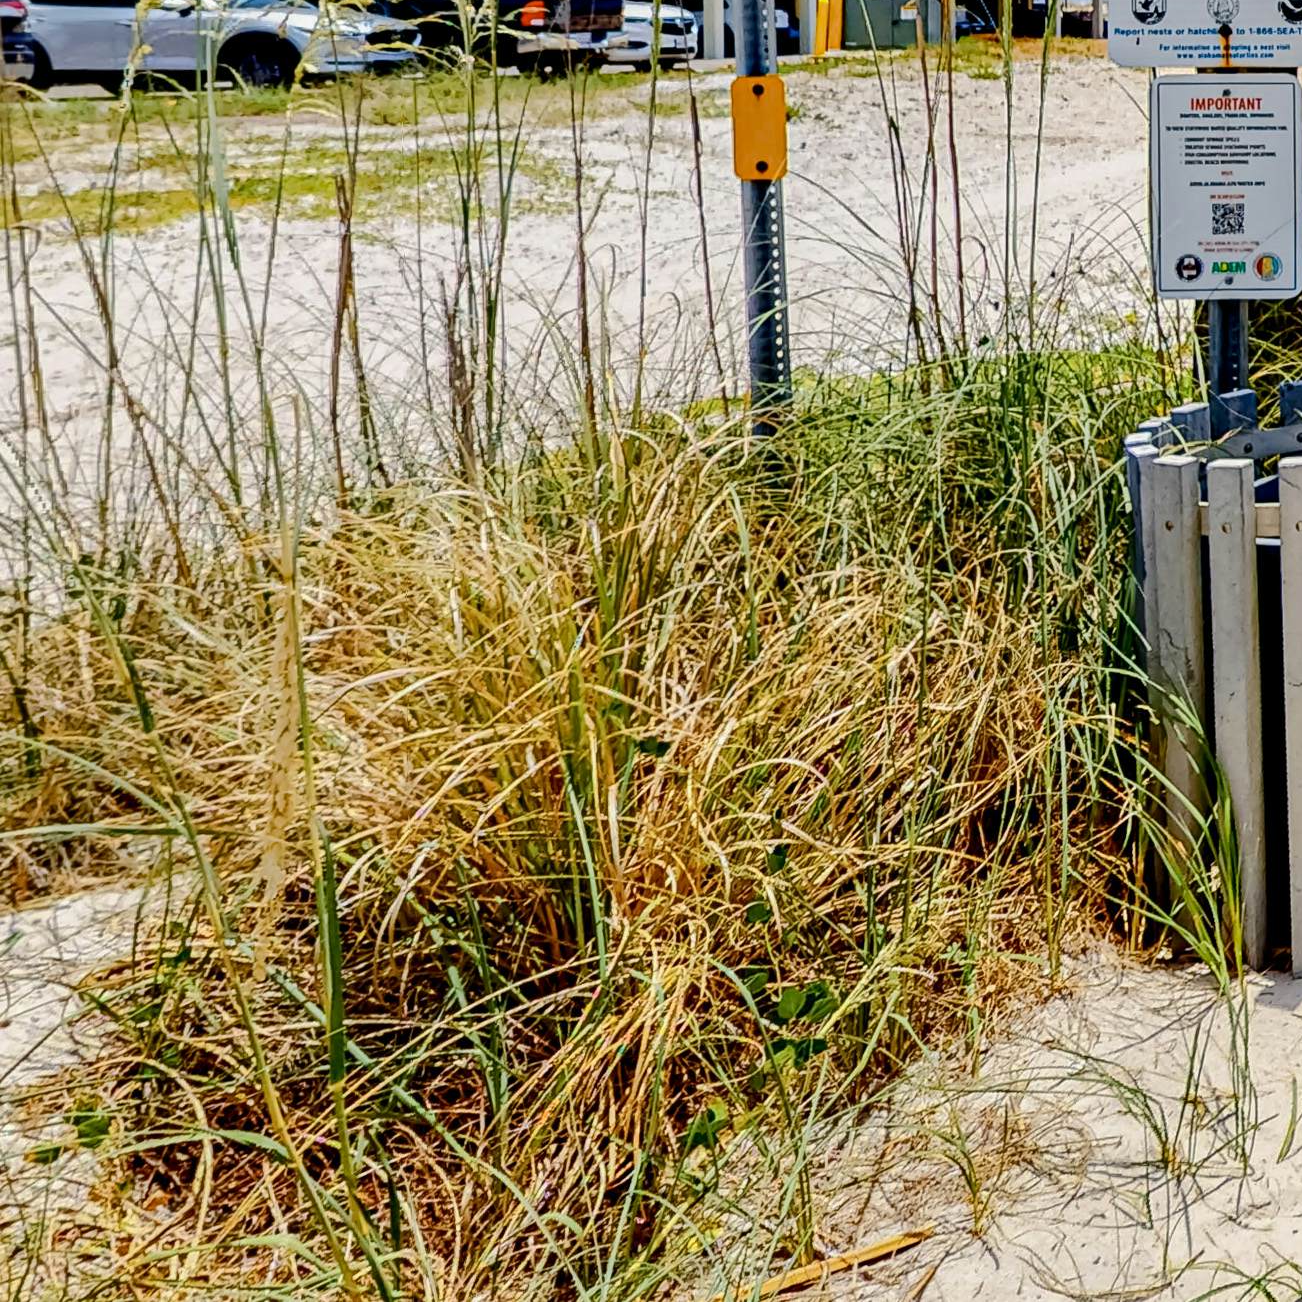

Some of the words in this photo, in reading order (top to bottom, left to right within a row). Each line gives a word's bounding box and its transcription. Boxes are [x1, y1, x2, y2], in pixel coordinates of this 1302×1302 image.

[1114, 28, 1145, 37] Report
[1190, 98, 1262, 111] IMPORTANT
[1212, 261, 1246, 274] ADEM
